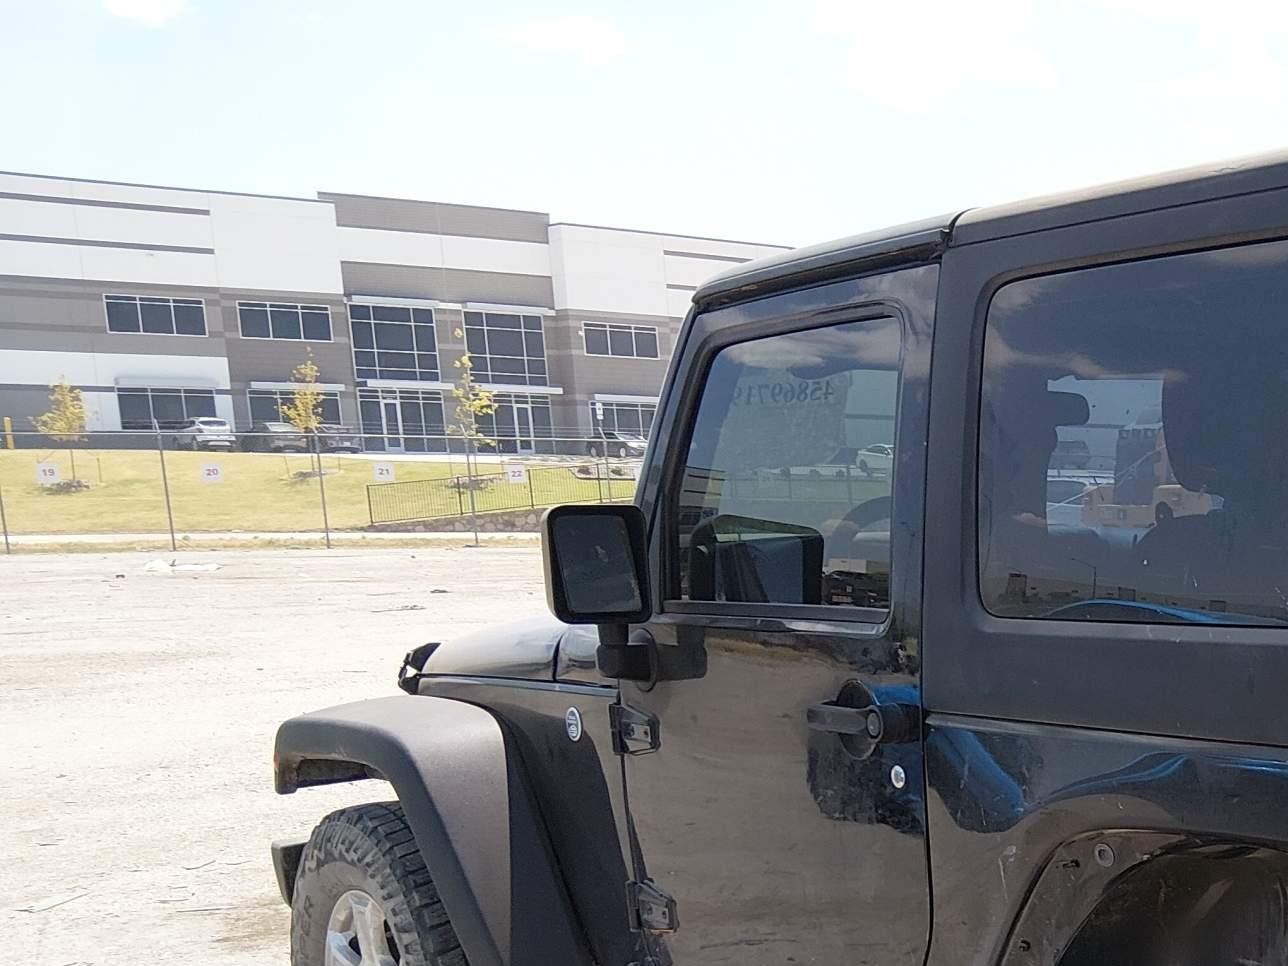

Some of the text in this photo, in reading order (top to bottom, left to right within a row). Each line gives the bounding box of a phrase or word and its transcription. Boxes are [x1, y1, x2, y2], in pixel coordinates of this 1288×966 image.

[41, 468, 56, 477] 19
[205, 467, 219, 477] 20
[377, 467, 391, 476] 21
[510, 469, 523, 478] 22
